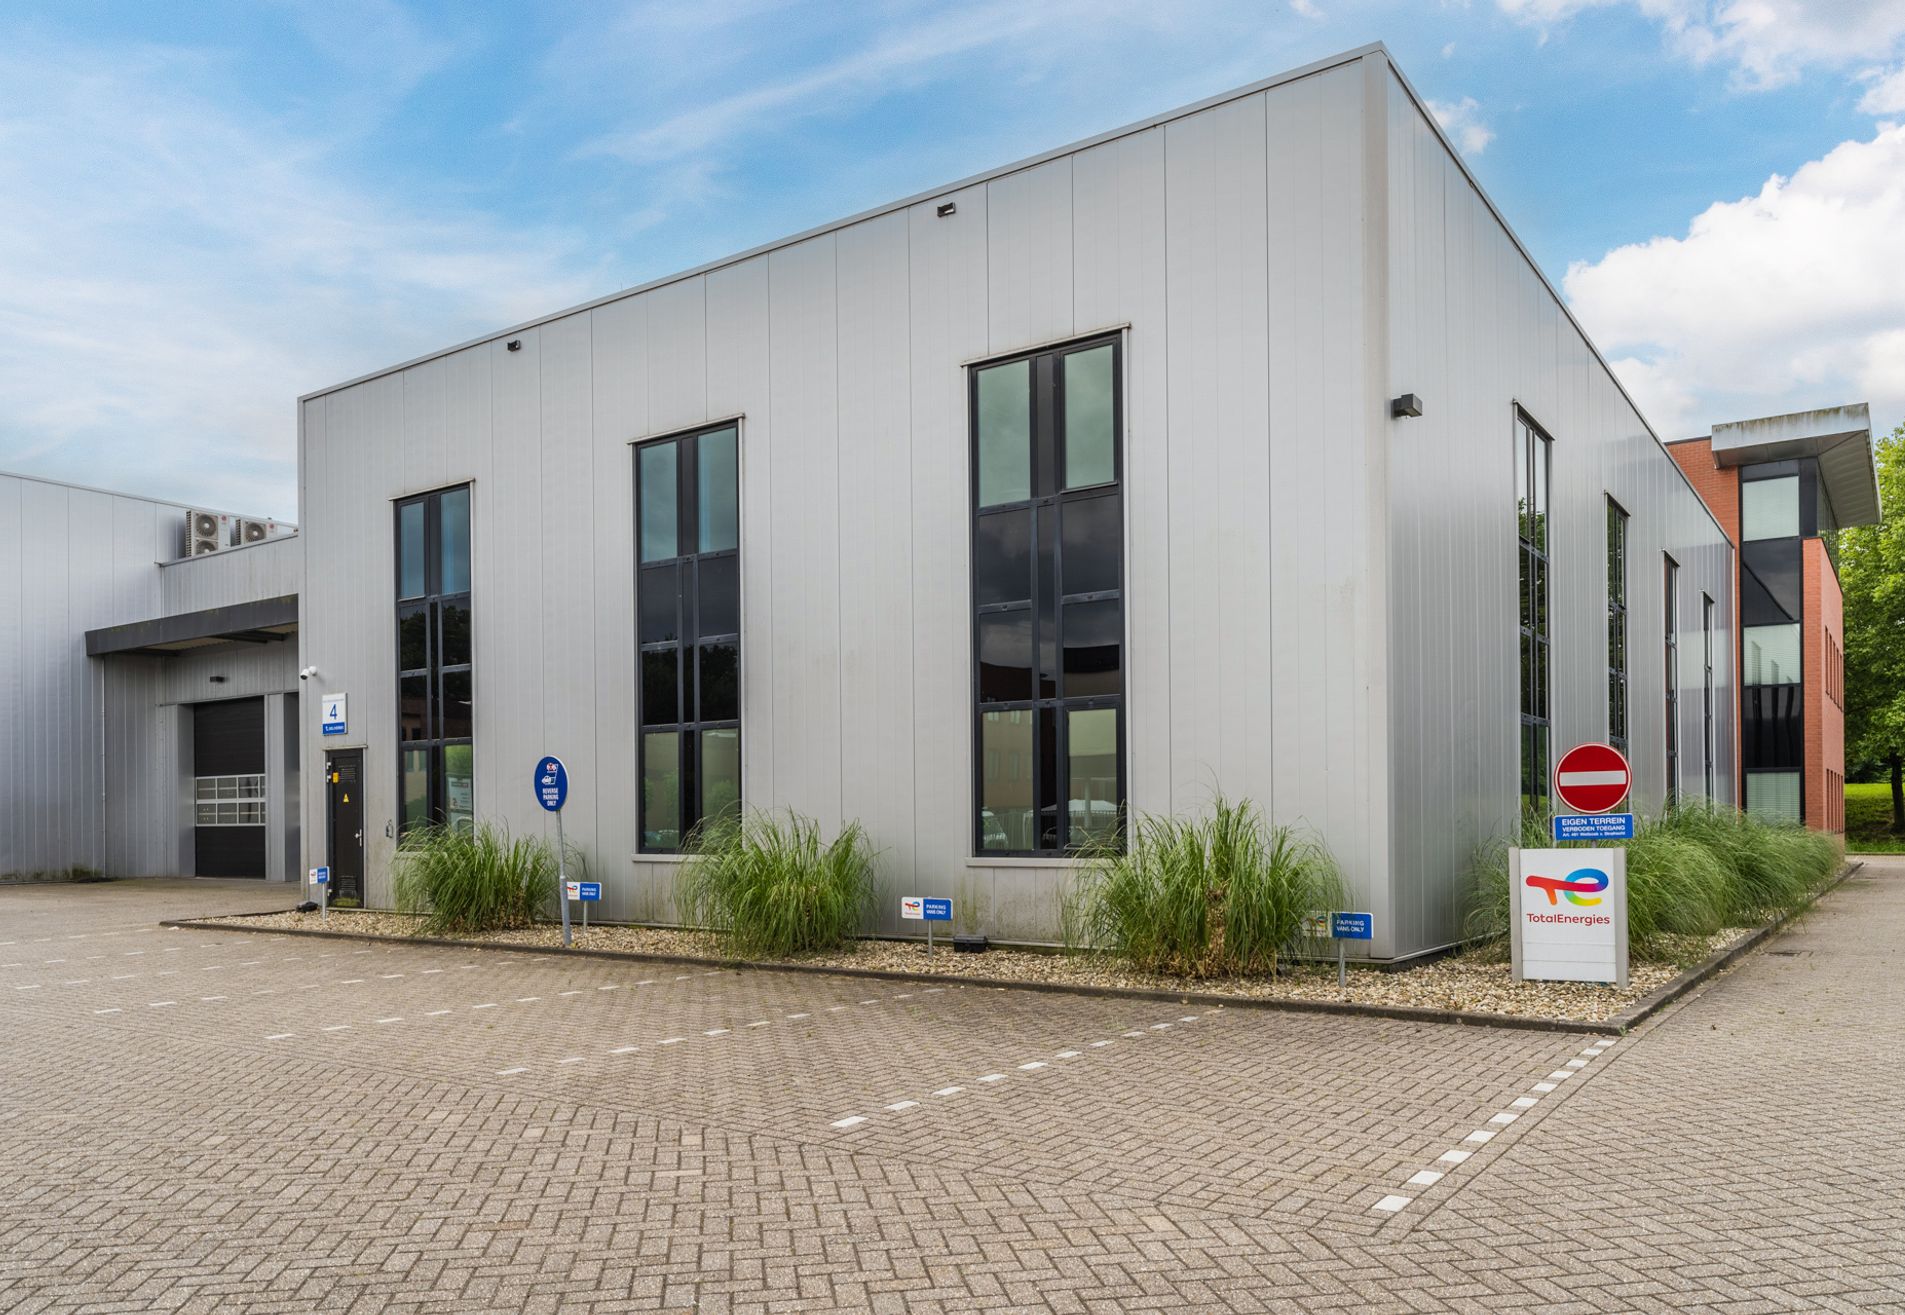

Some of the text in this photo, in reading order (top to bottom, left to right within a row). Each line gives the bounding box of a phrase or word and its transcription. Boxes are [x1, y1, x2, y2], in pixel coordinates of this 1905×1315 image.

[329, 703, 338, 720] 4
[1561, 816, 1626, 826] EIGEN TERREIN
[1561, 824, 1626, 833] VERBODEN TOEGANG
[1526, 912, 1610, 927] TotalEnergies
